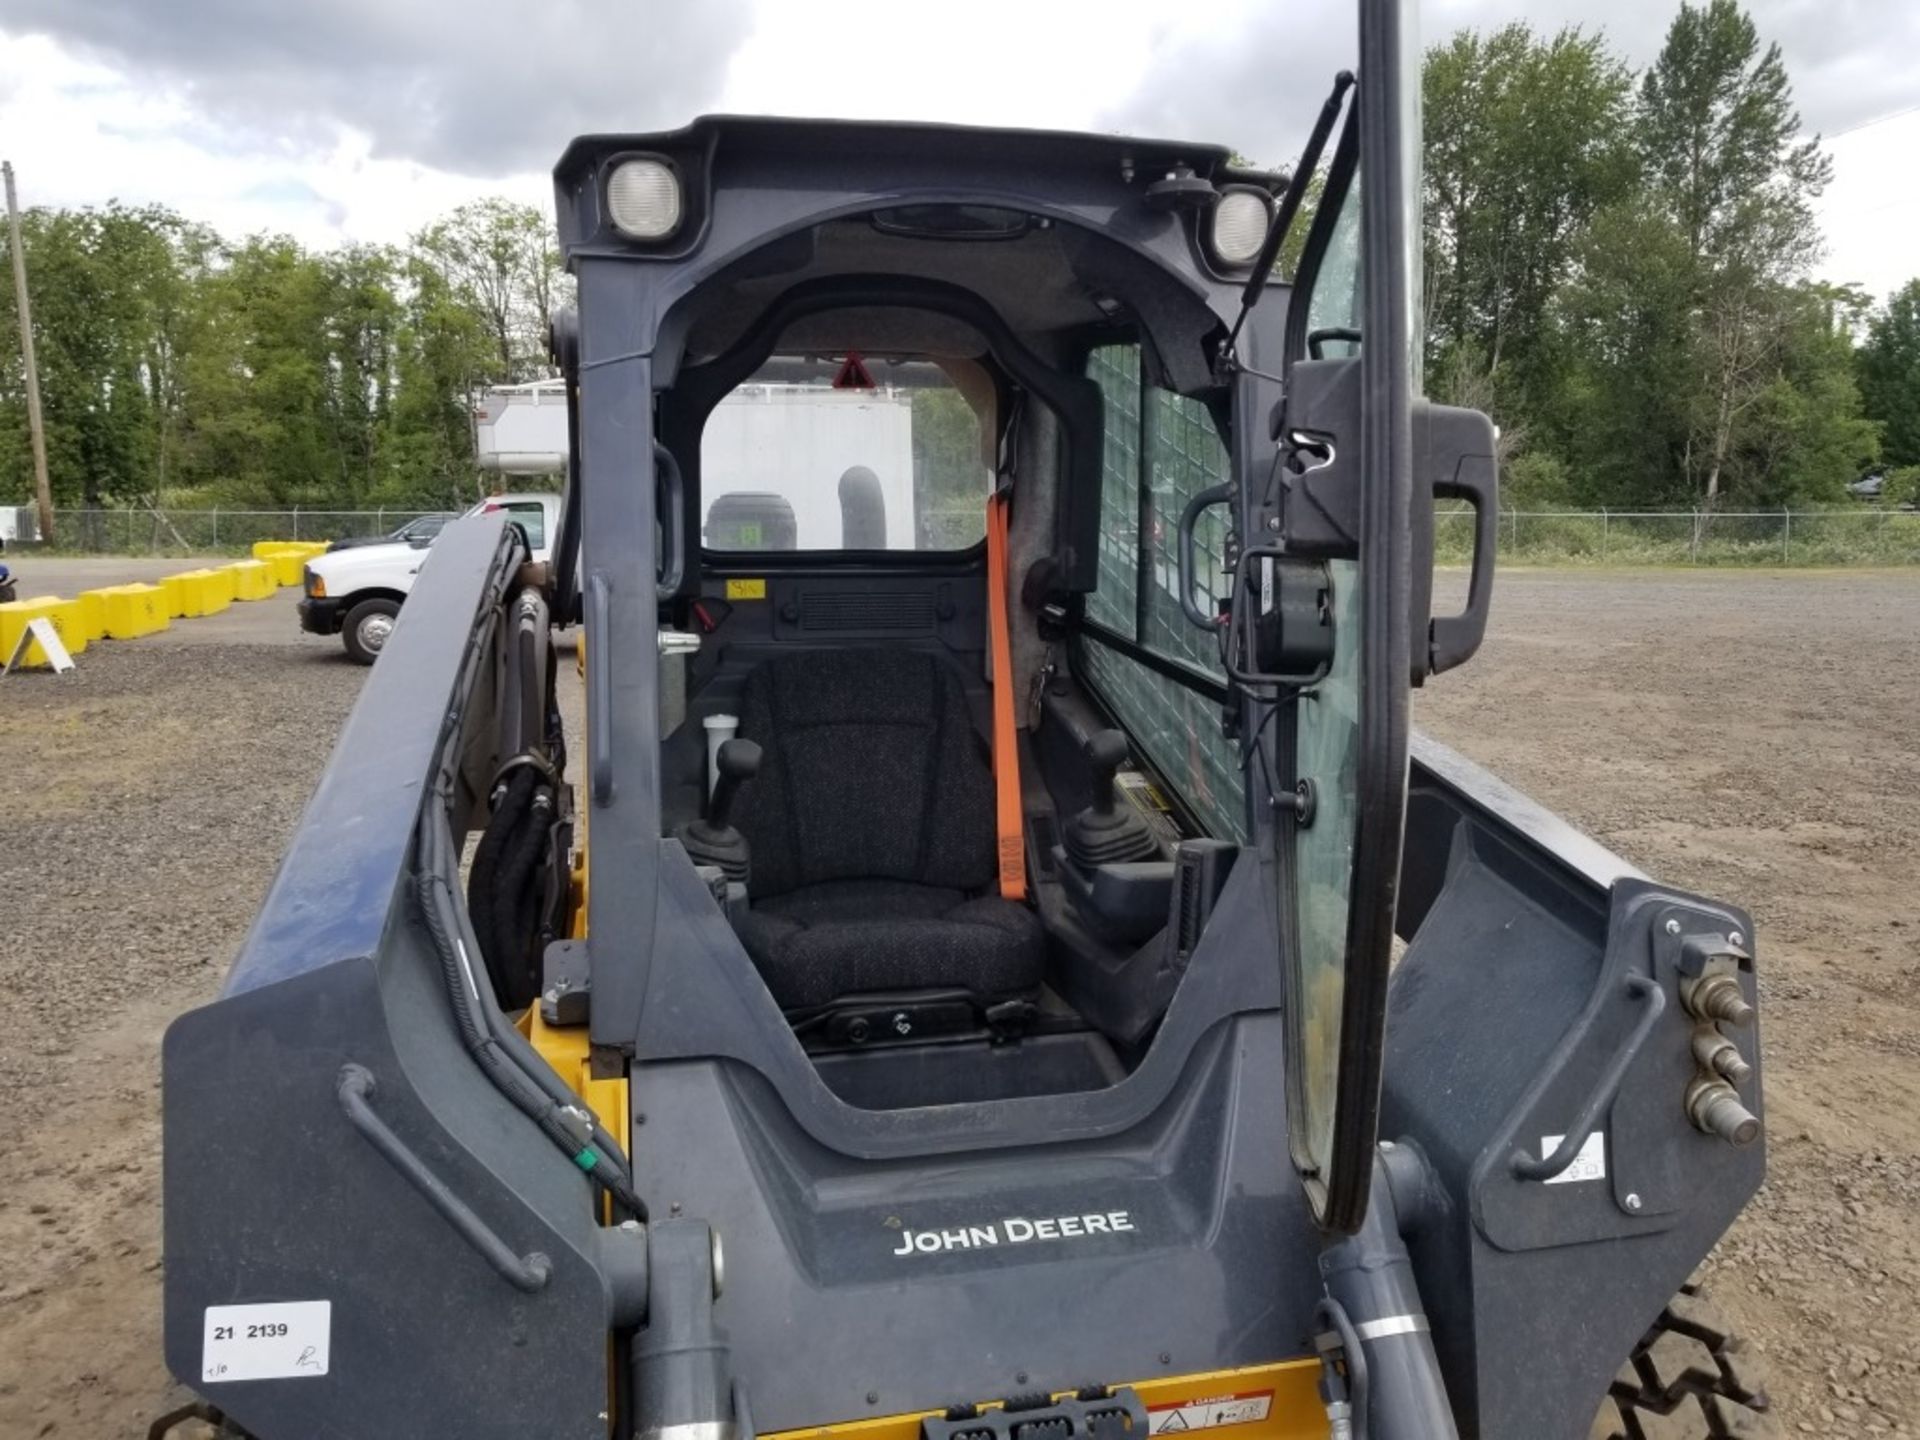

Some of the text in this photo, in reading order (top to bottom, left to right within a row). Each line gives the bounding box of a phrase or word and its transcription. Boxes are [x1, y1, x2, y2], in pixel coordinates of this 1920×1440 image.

[894, 1211, 1134, 1255] JOHN DEERE
[213, 1323, 288, 1341] 21 2139
